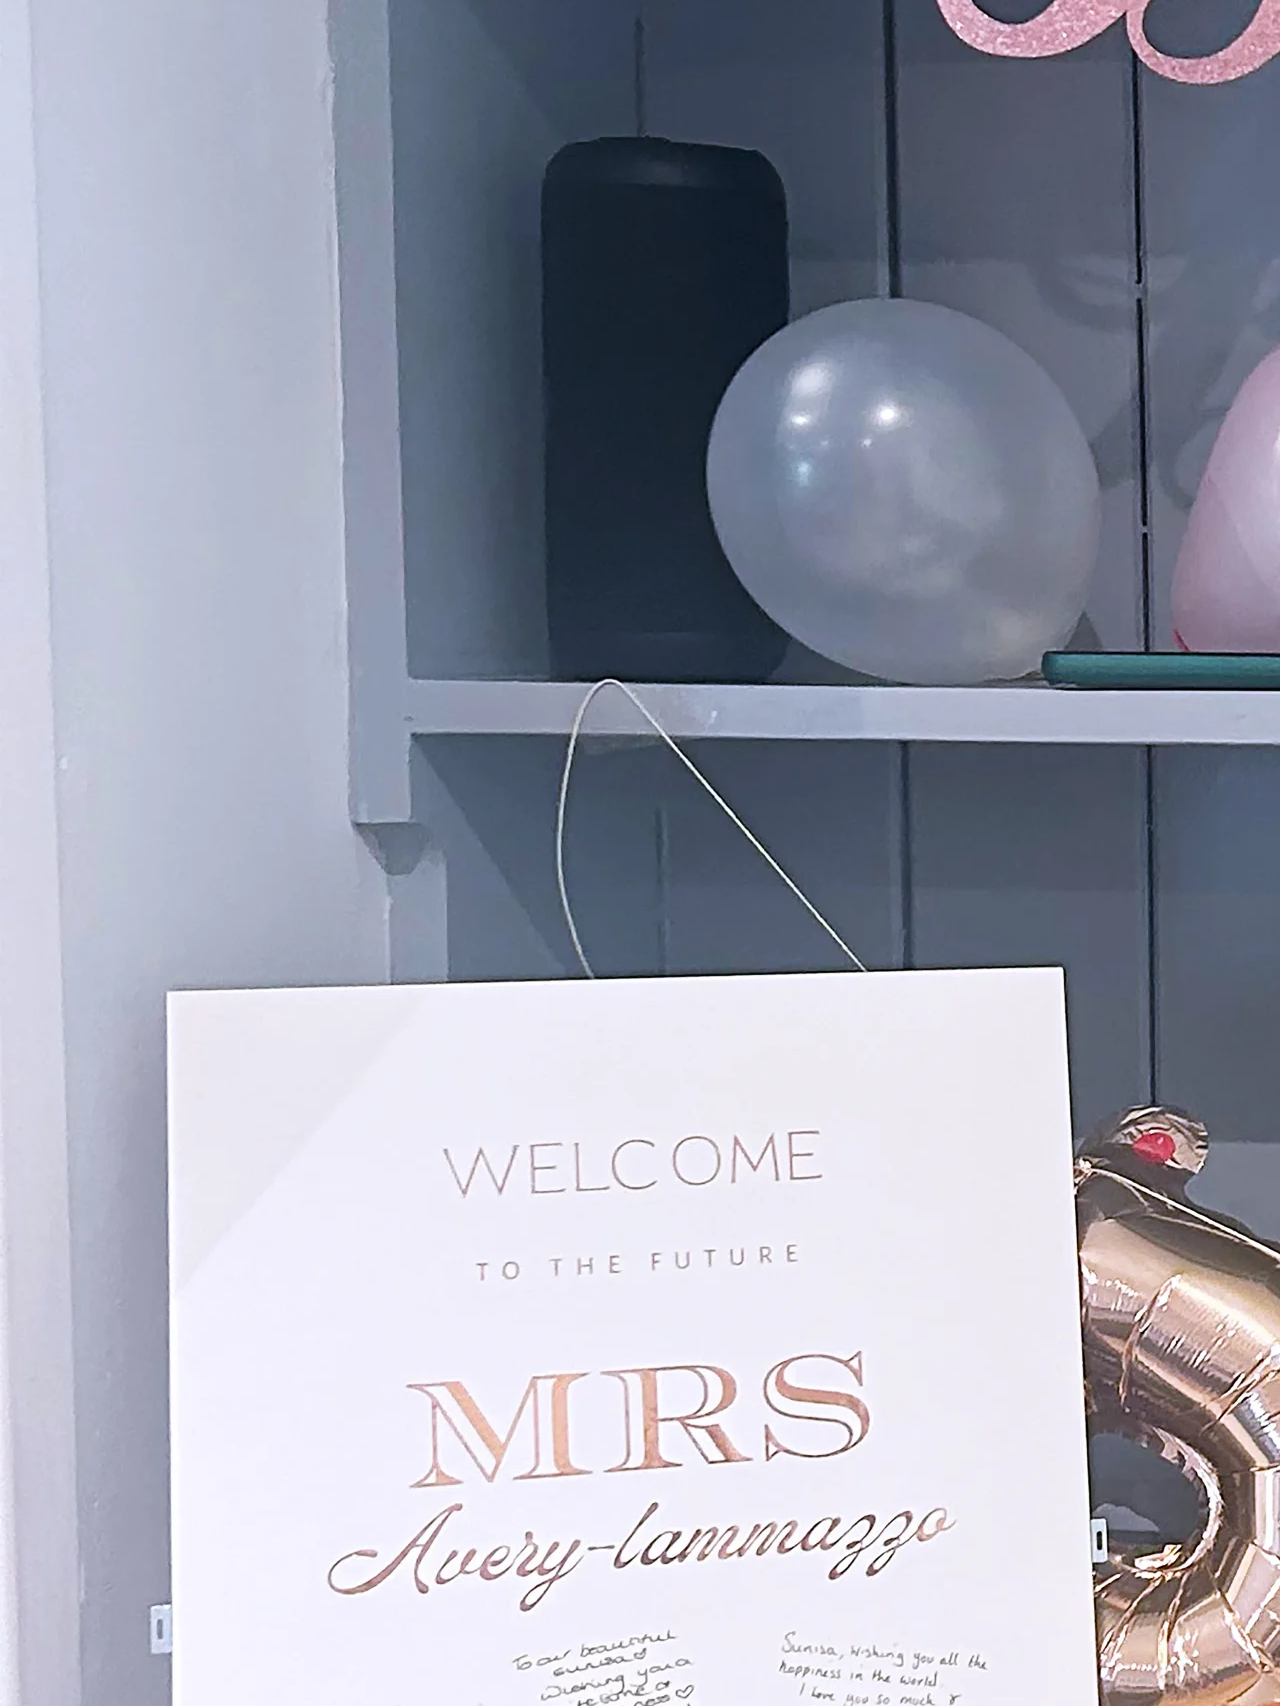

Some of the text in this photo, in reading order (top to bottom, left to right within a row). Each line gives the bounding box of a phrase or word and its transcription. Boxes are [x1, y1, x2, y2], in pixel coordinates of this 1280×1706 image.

[443, 1130, 823, 1198] WELCOME
[476, 1243, 799, 1281] TO THE FUTURE
[406, 1351, 871, 1489] MRS
[913, 1652, 934, 1669] you
[939, 1652, 959, 1665] all
[968, 1654, 988, 1671] the
[850, 1672, 863, 1681] in
[872, 1669, 891, 1683] the
[900, 1694, 935, 1706] much
